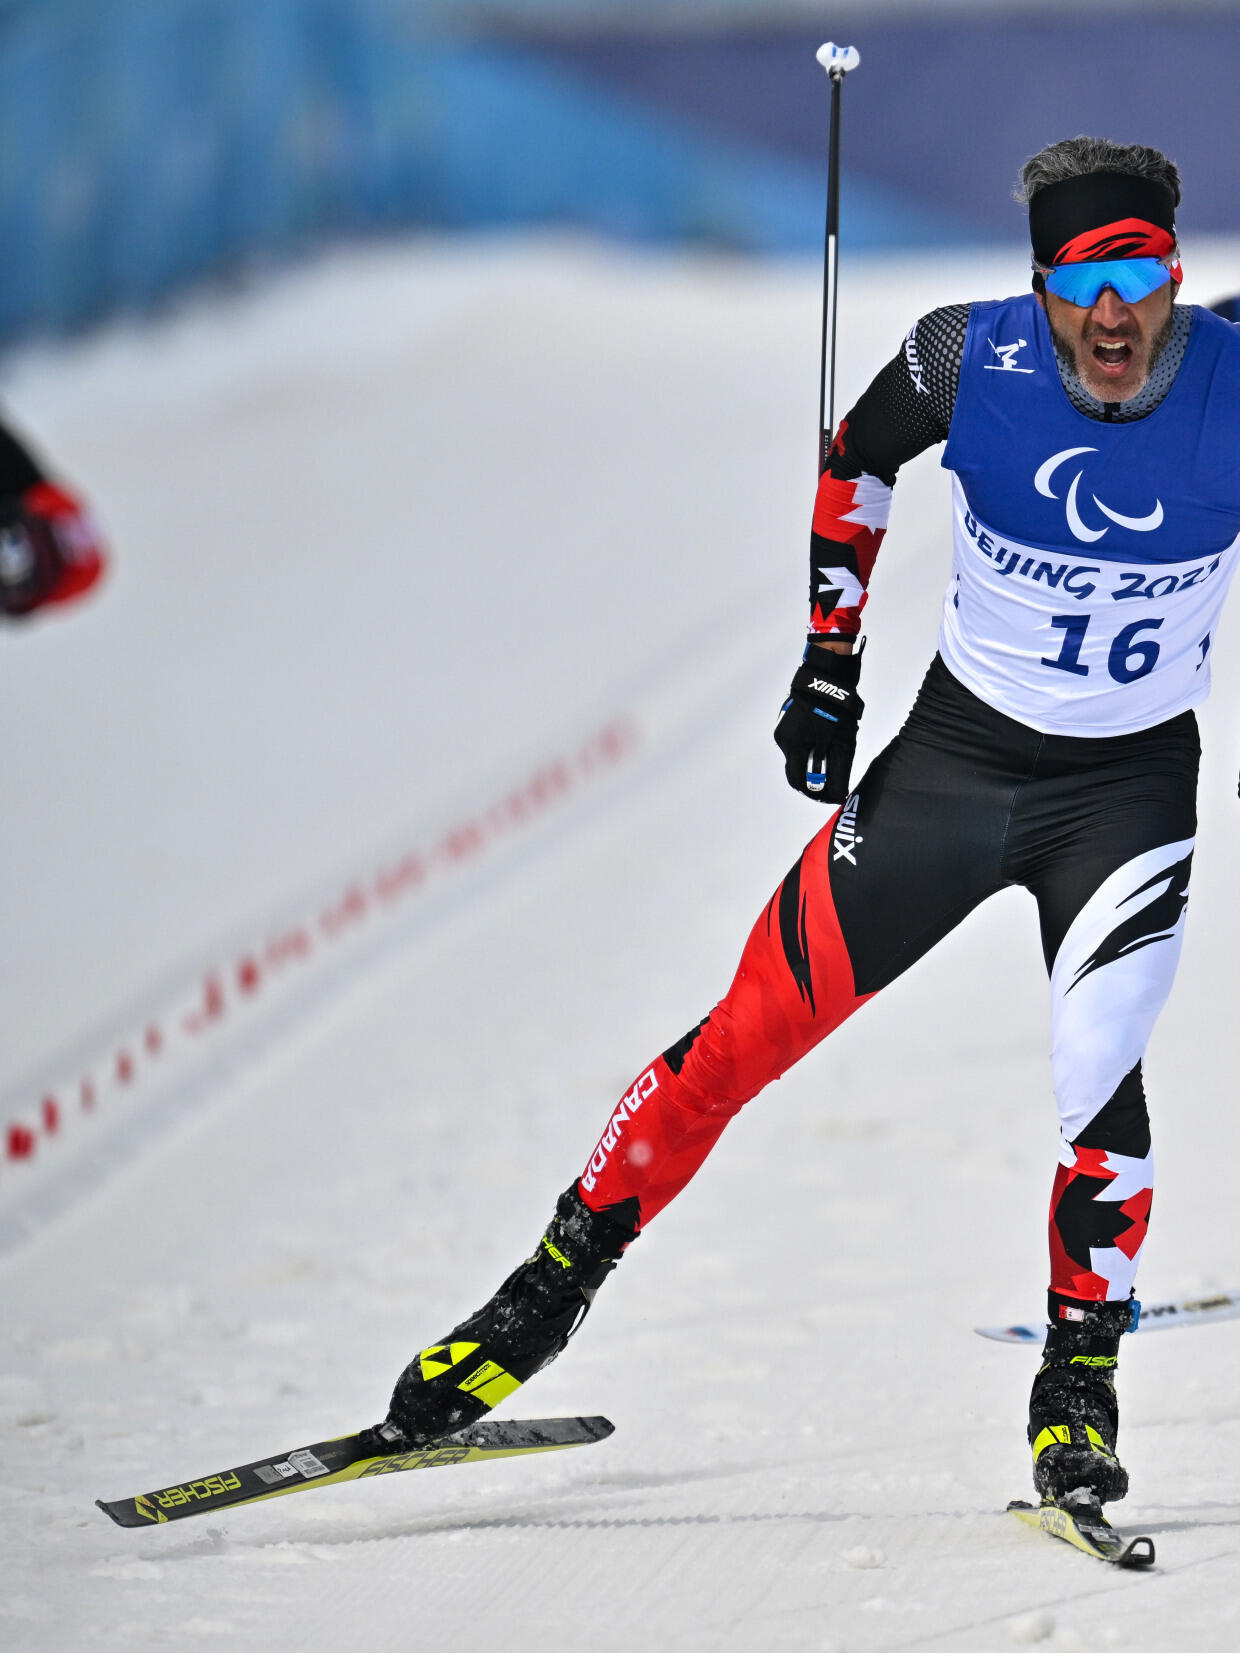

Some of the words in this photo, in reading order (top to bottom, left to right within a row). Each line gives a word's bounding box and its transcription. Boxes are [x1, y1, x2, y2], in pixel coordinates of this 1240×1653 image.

[1041, 615, 1165, 684] 16
[578, 1068, 659, 1192] CANADA
[357, 1447, 471, 1479] FISCHER
[152, 1472, 242, 1508] FISCHER
